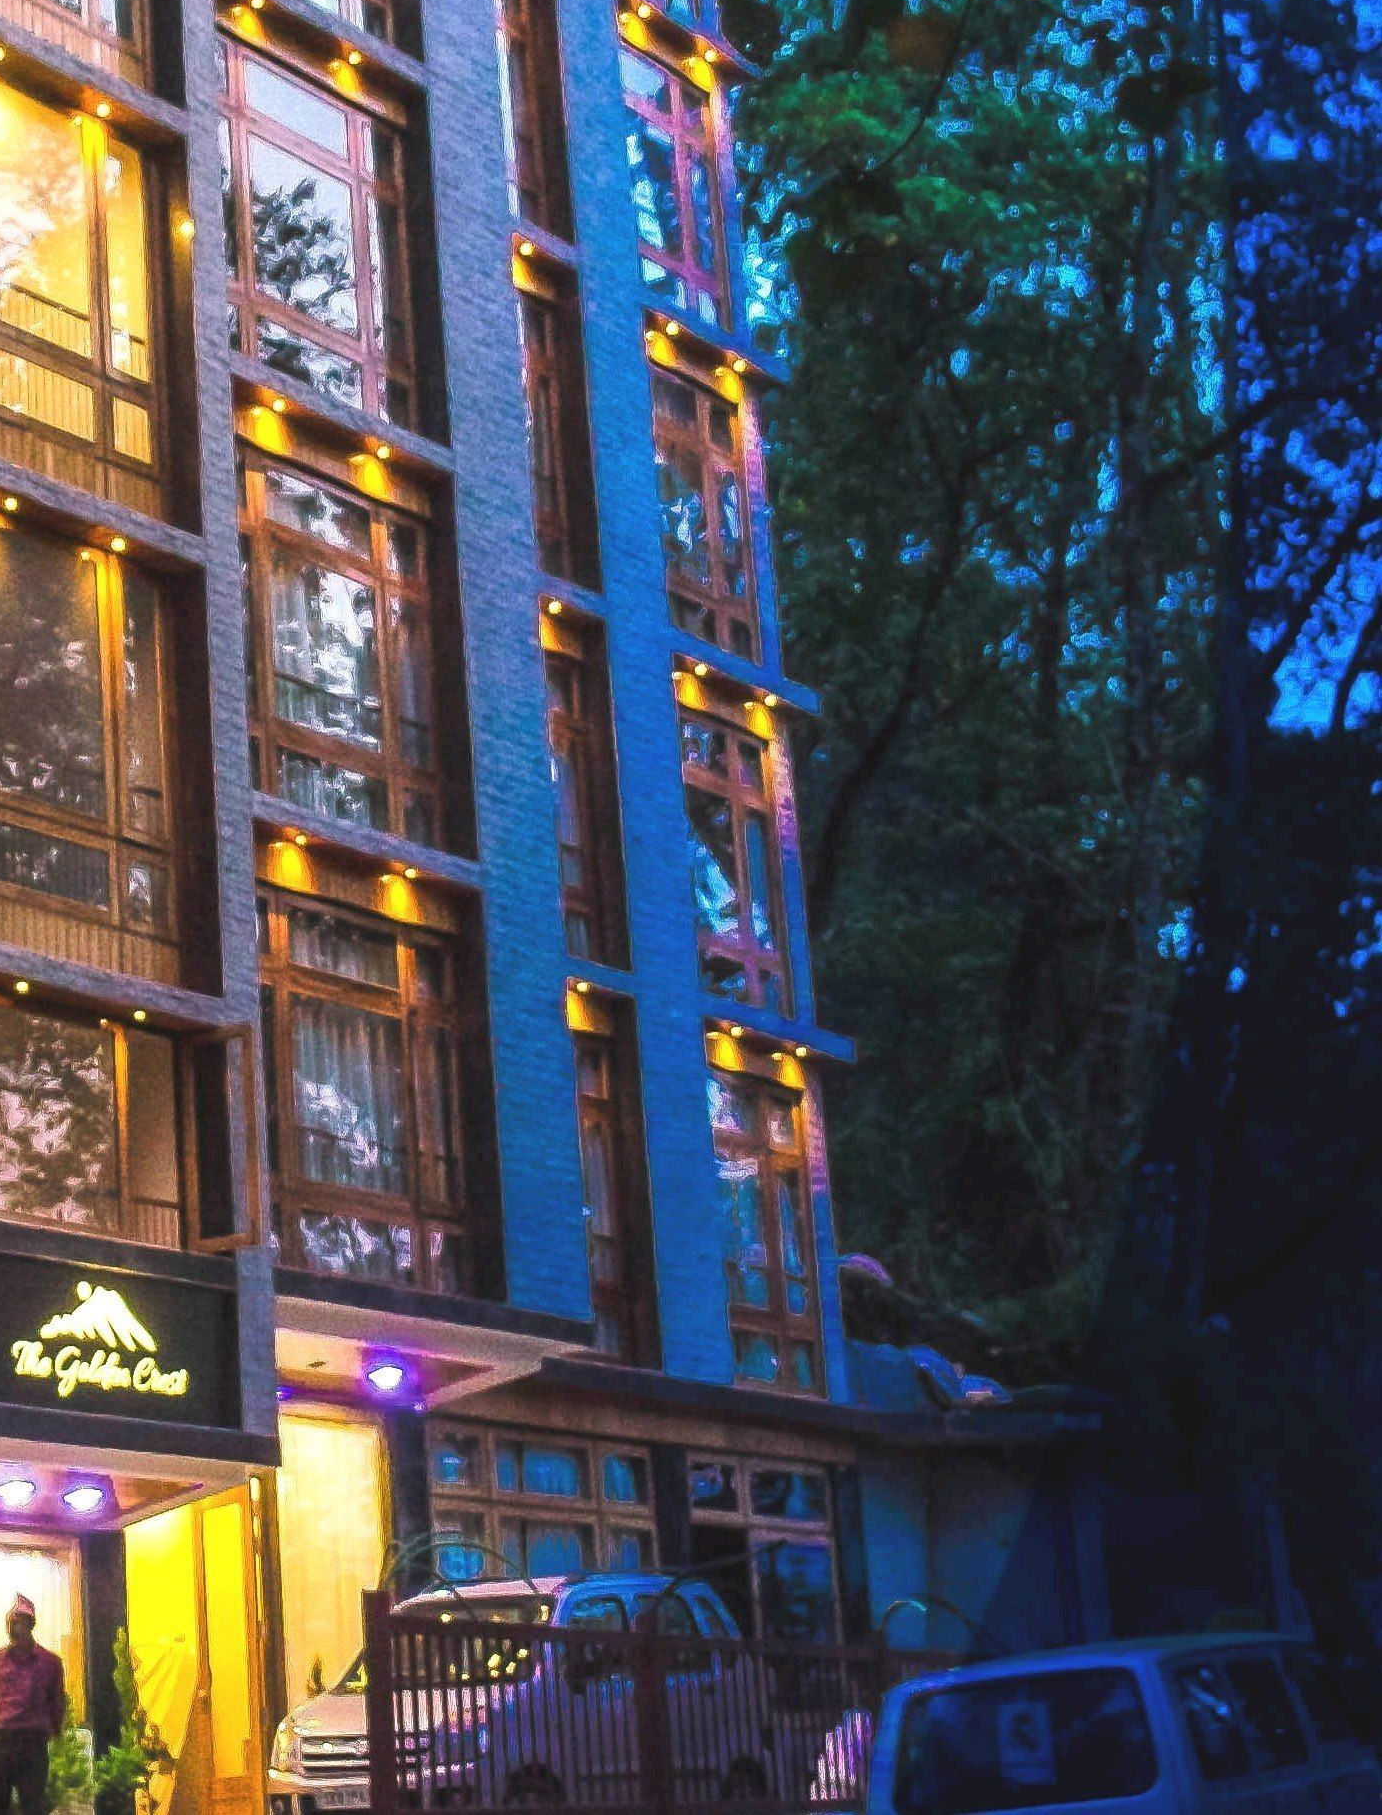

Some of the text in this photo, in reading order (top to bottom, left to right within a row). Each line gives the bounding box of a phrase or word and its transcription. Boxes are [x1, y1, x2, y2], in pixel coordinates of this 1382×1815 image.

[11, 1340, 189, 1397] The Golden Crest
